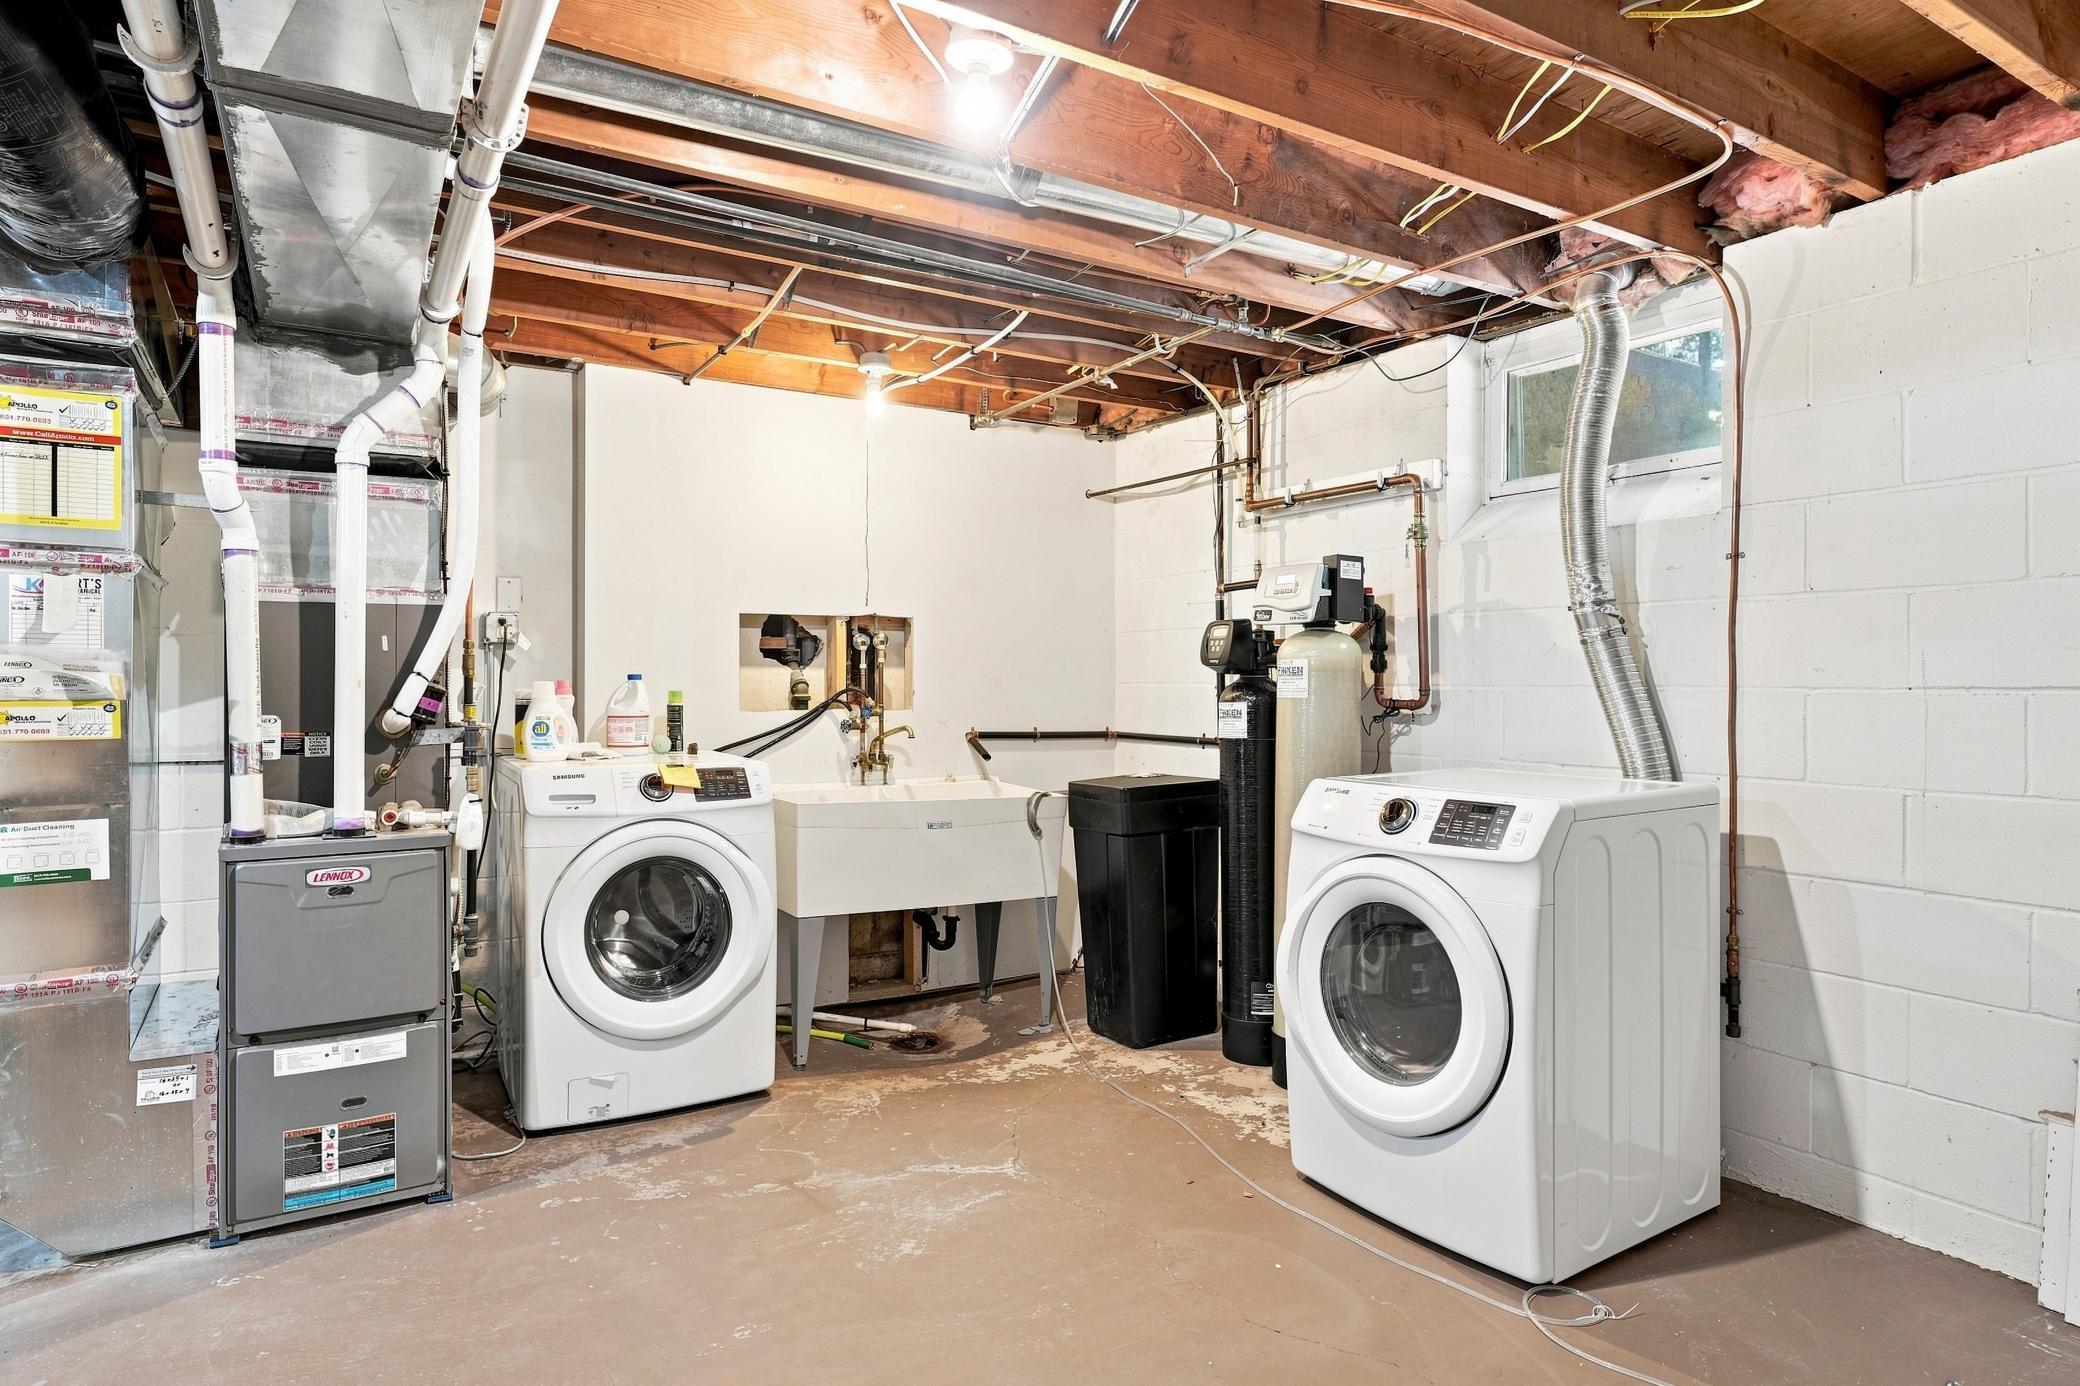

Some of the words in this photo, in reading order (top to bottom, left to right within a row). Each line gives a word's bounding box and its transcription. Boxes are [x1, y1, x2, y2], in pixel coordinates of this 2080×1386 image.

[8, 401, 38, 410] APOLLO
[12, 429, 95, 442] www.CallApollo.com
[534, 723, 547, 734] all
[552, 773, 586, 781] SAMSUNG
[42, 823, 75, 831] Cleaning
[313, 870, 355, 883] LENNOX
